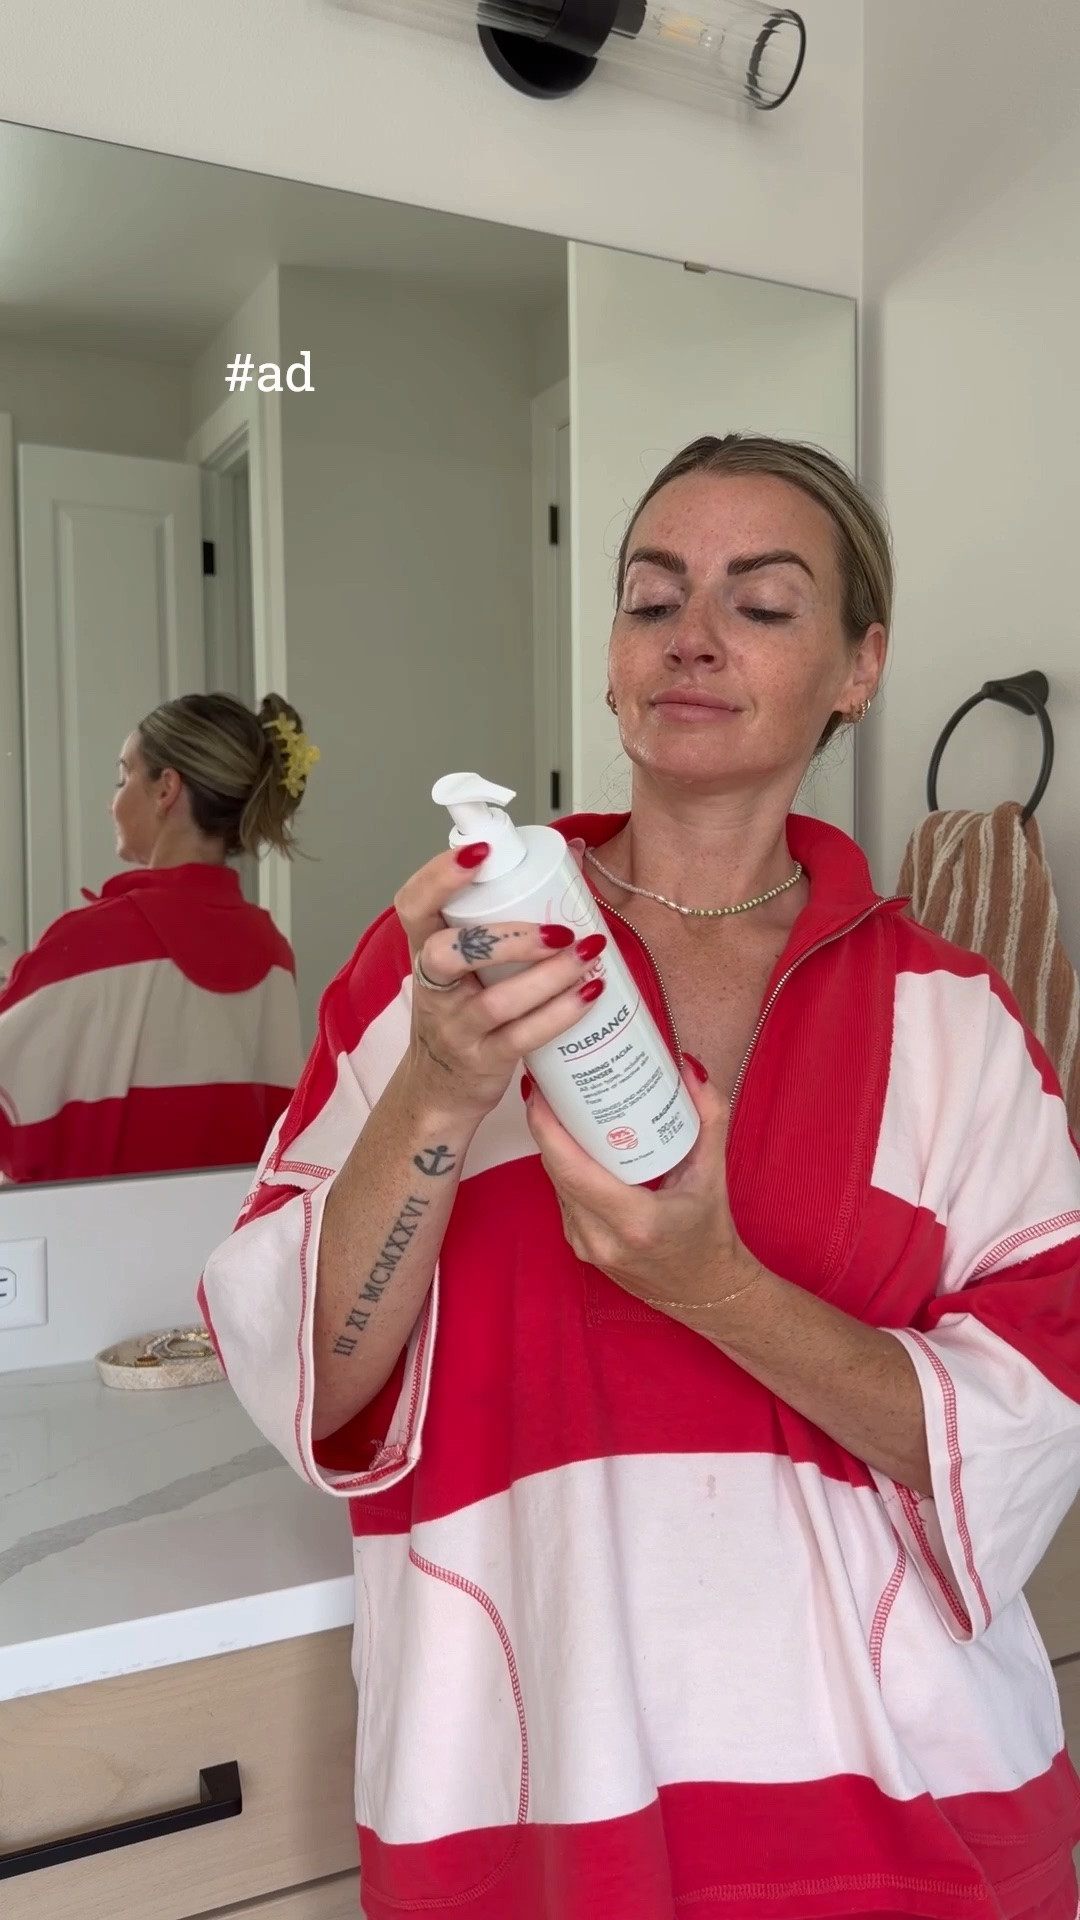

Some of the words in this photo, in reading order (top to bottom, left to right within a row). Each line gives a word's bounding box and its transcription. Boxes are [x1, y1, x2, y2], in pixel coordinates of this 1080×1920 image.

[557, 1004, 630, 1056] TOLERANCE
[571, 1061, 610, 1080] FOAMING
[611, 1043, 634, 1063] FACIAL
[575, 1067, 614, 1086] CLEANSER
[359, 1195, 430, 1303] MCMXXVI
[345, 1307, 371, 1332] XI
[333, 1335, 358, 1357] III
